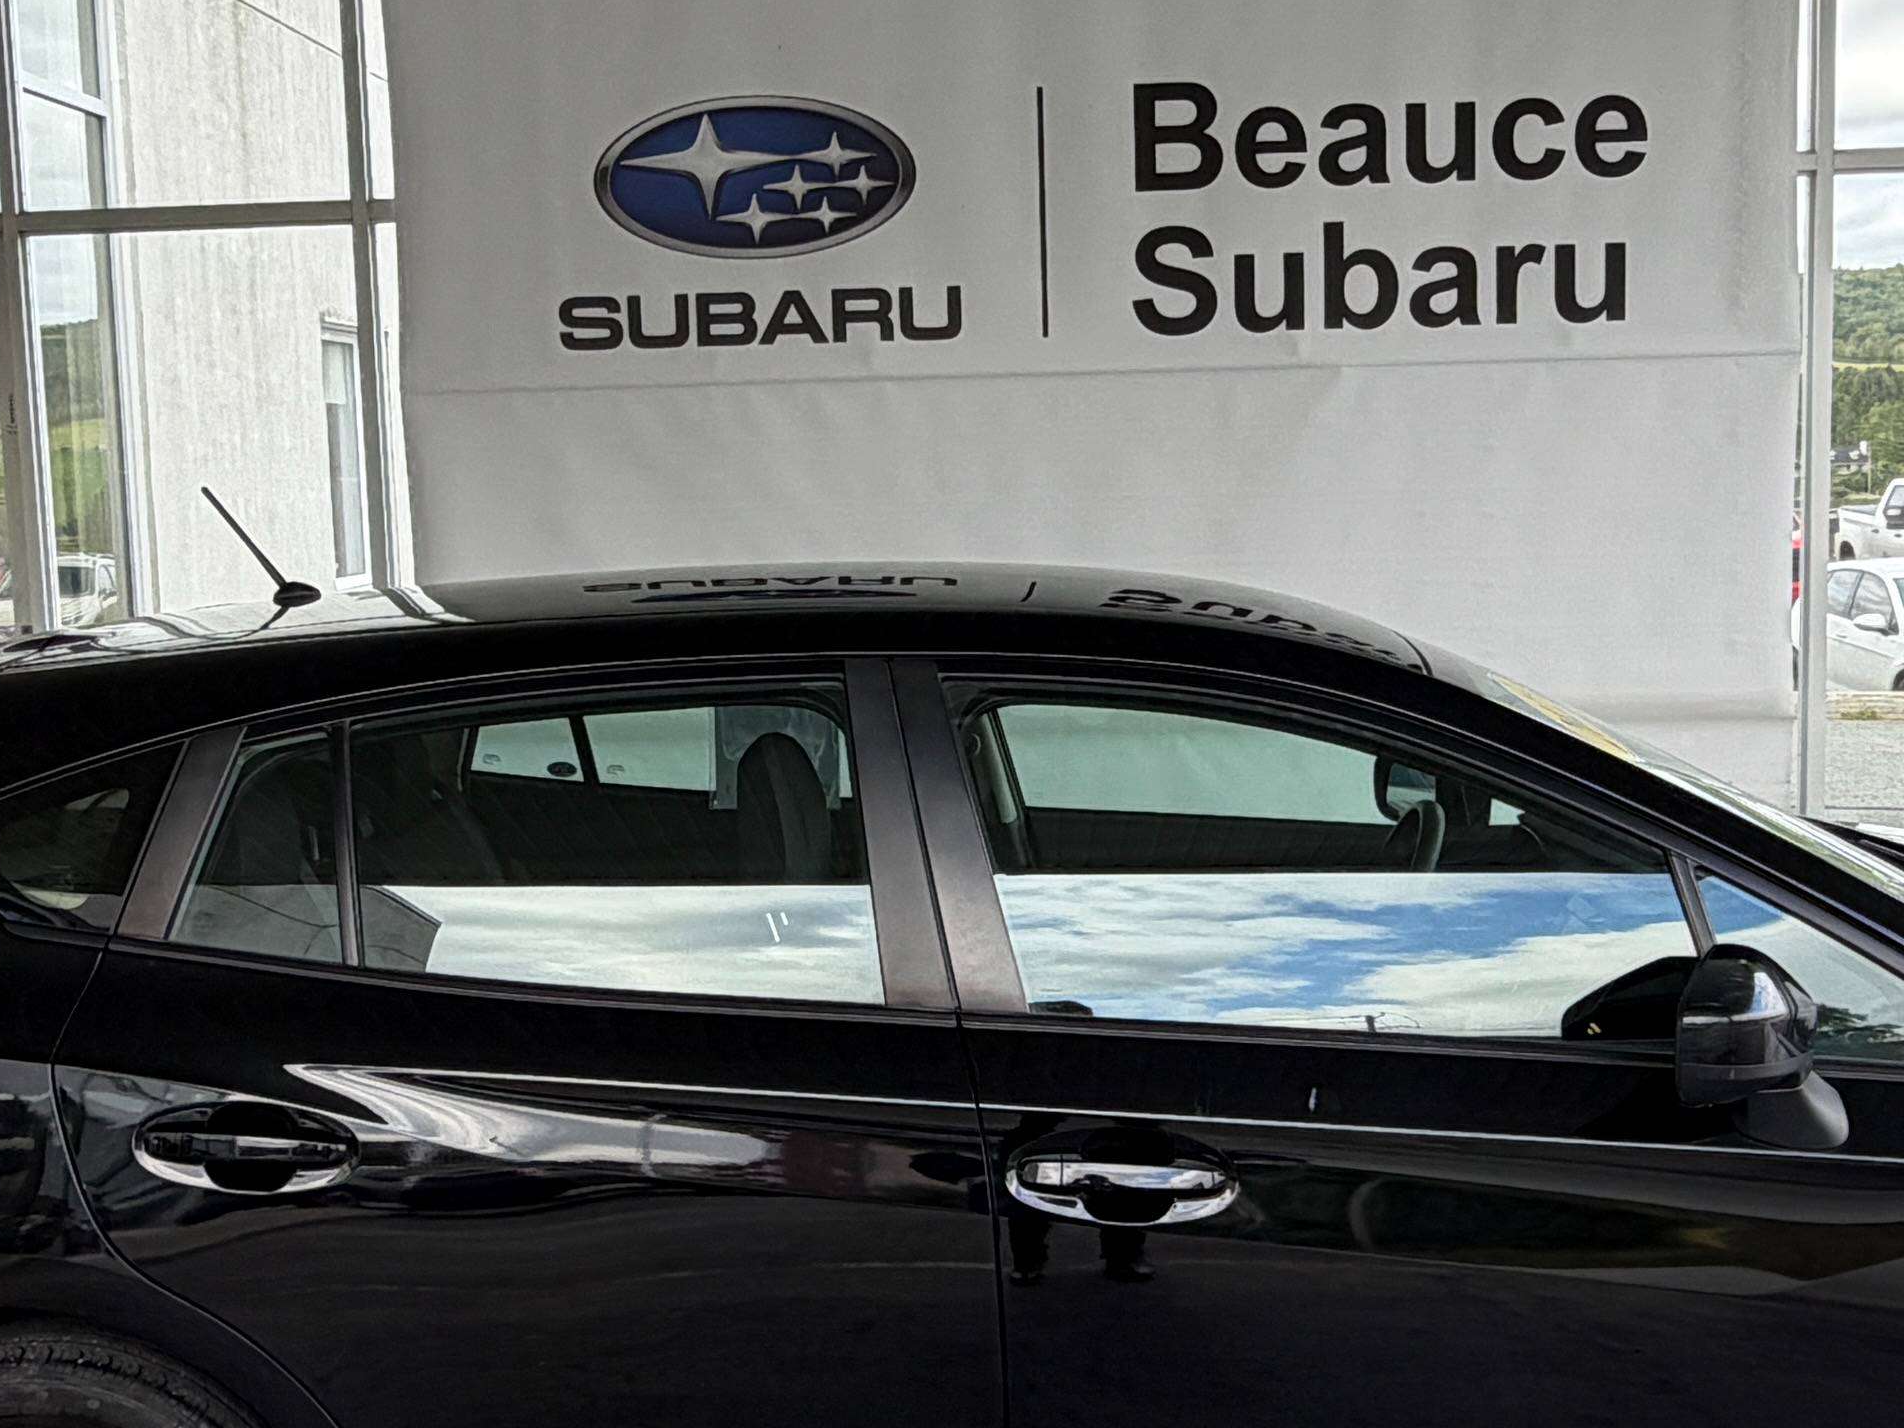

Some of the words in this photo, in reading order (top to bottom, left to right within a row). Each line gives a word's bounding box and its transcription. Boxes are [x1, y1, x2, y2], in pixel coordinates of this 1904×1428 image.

[1131, 82, 1649, 192] Beauce
[559, 286, 963, 350] SUBARU
[1132, 222, 1627, 335] Subaru
